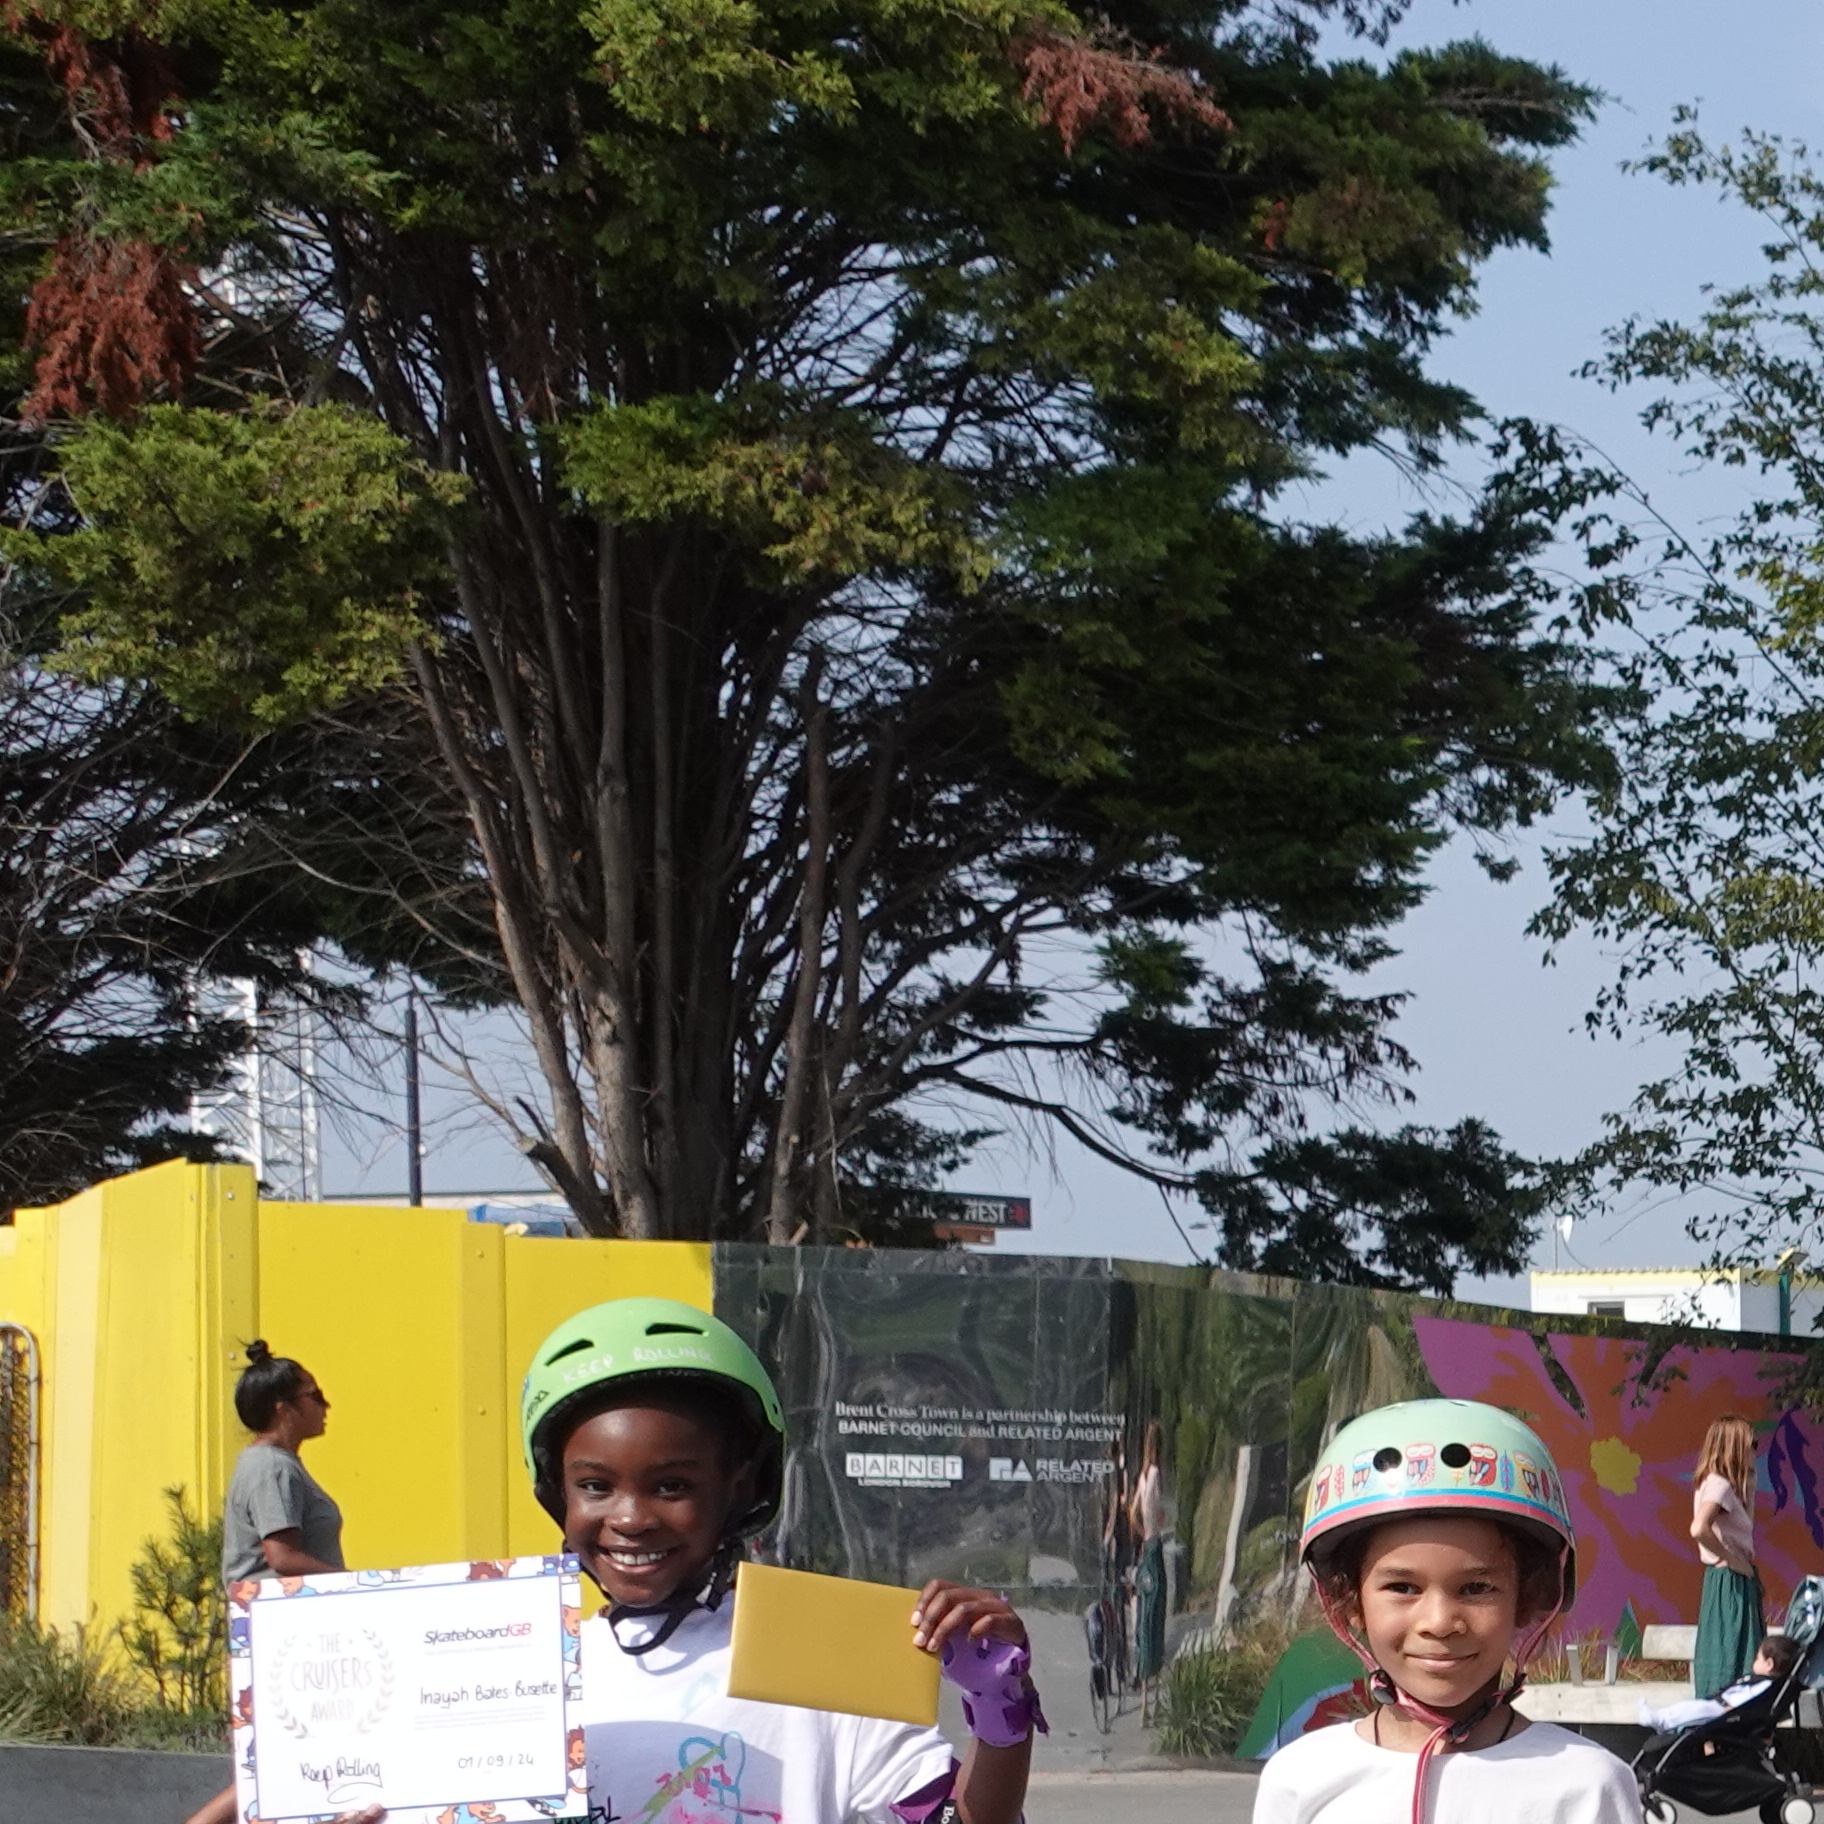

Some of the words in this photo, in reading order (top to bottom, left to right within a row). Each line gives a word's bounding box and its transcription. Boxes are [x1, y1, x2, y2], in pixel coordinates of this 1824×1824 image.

[562, 1353, 614, 1384] KEEP
[633, 1346, 714, 1364] ROLLING
[835, 1401, 873, 1417] Brent
[875, 1402, 917, 1418] Cross
[921, 1404, 958, 1420] Town
[986, 1406, 1068, 1427] partnership
[1070, 1407, 1126, 1426] between
[838, 1419, 896, 1436] BARNET
[900, 1422, 965, 1438] COUNCIL
[969, 1423, 994, 1438] and
[999, 1425, 1062, 1441] RELATED
[1065, 1427, 1124, 1443] ARGENT
[847, 1455, 961, 1478] BARNET
[1036, 1458, 1115, 1475] RELATED
[318, 1632, 342, 1654] THE
[424, 1623, 532, 1645] SkateboardGB
[290, 1657, 373, 1695] CRUISERS
